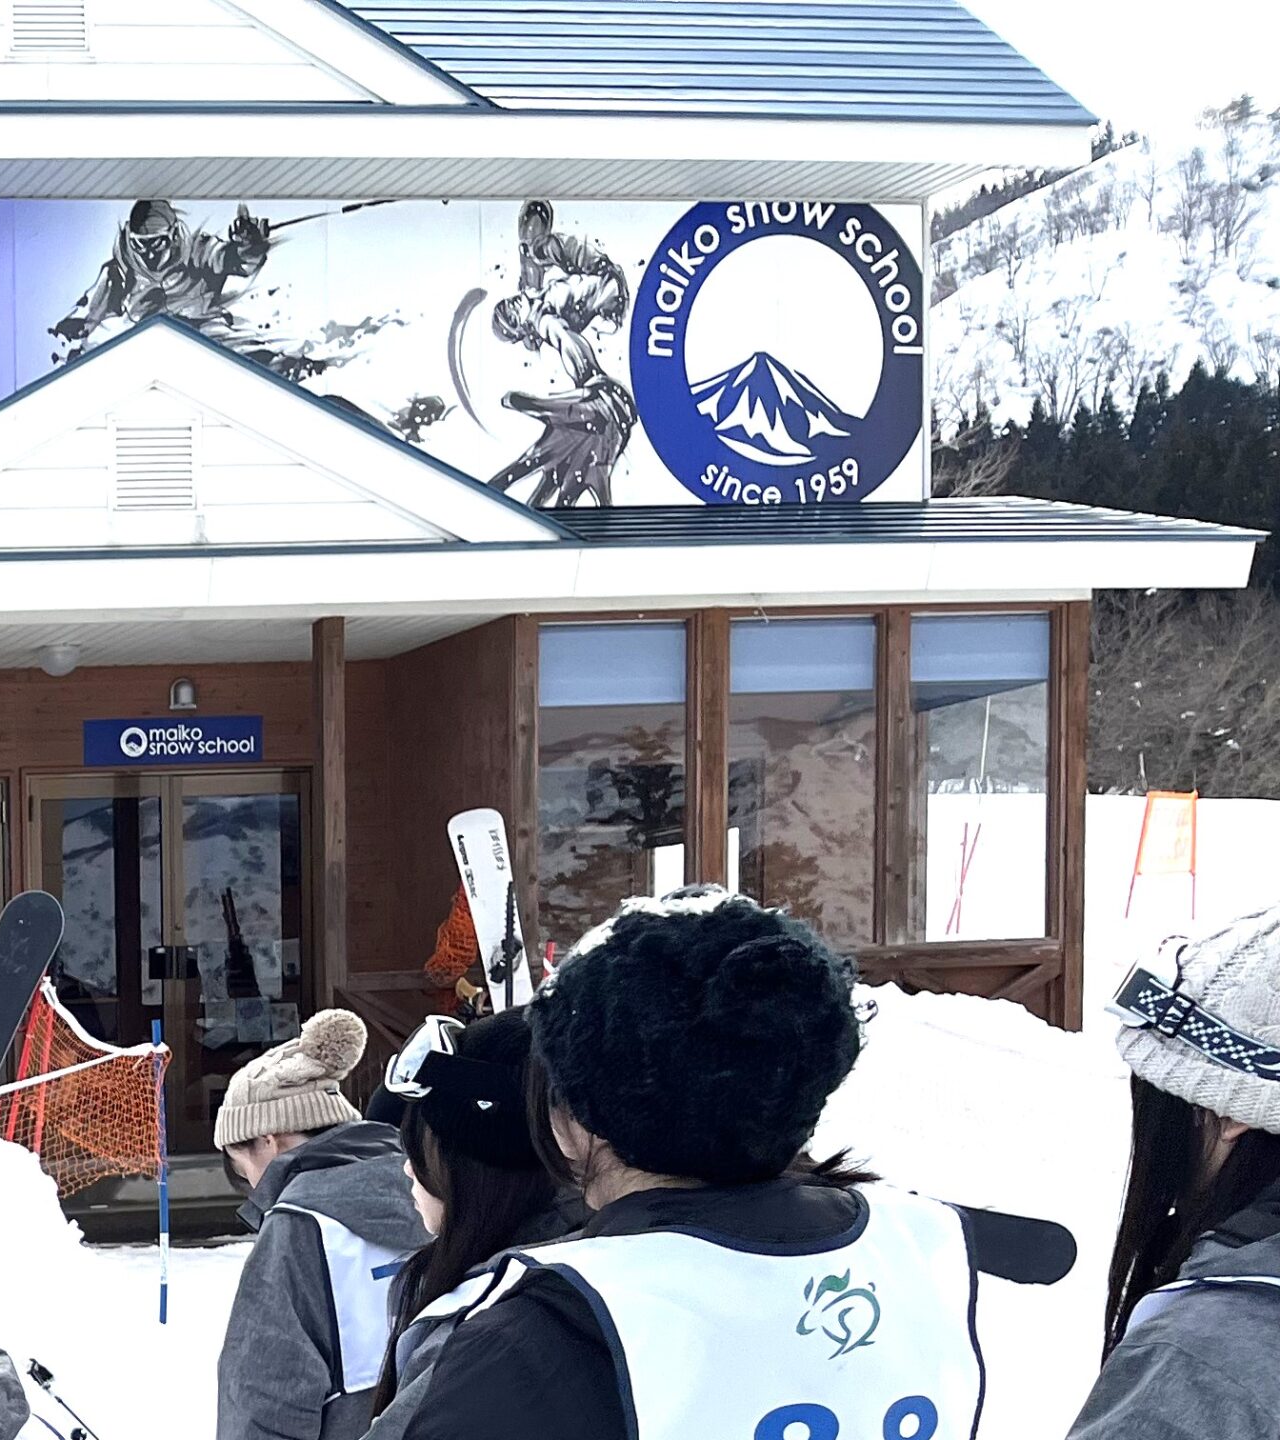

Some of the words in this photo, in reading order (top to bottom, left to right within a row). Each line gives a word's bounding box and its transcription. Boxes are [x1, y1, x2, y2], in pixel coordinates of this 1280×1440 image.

[648, 224, 720, 357] maiko
[726, 201, 835, 233] snow
[839, 217, 923, 355] school
[701, 464, 781, 504] since
[795, 458, 859, 503] 1959
[149, 724, 202, 741] maiko
[149, 741, 194, 755] snow
[198, 736, 254, 754] school
